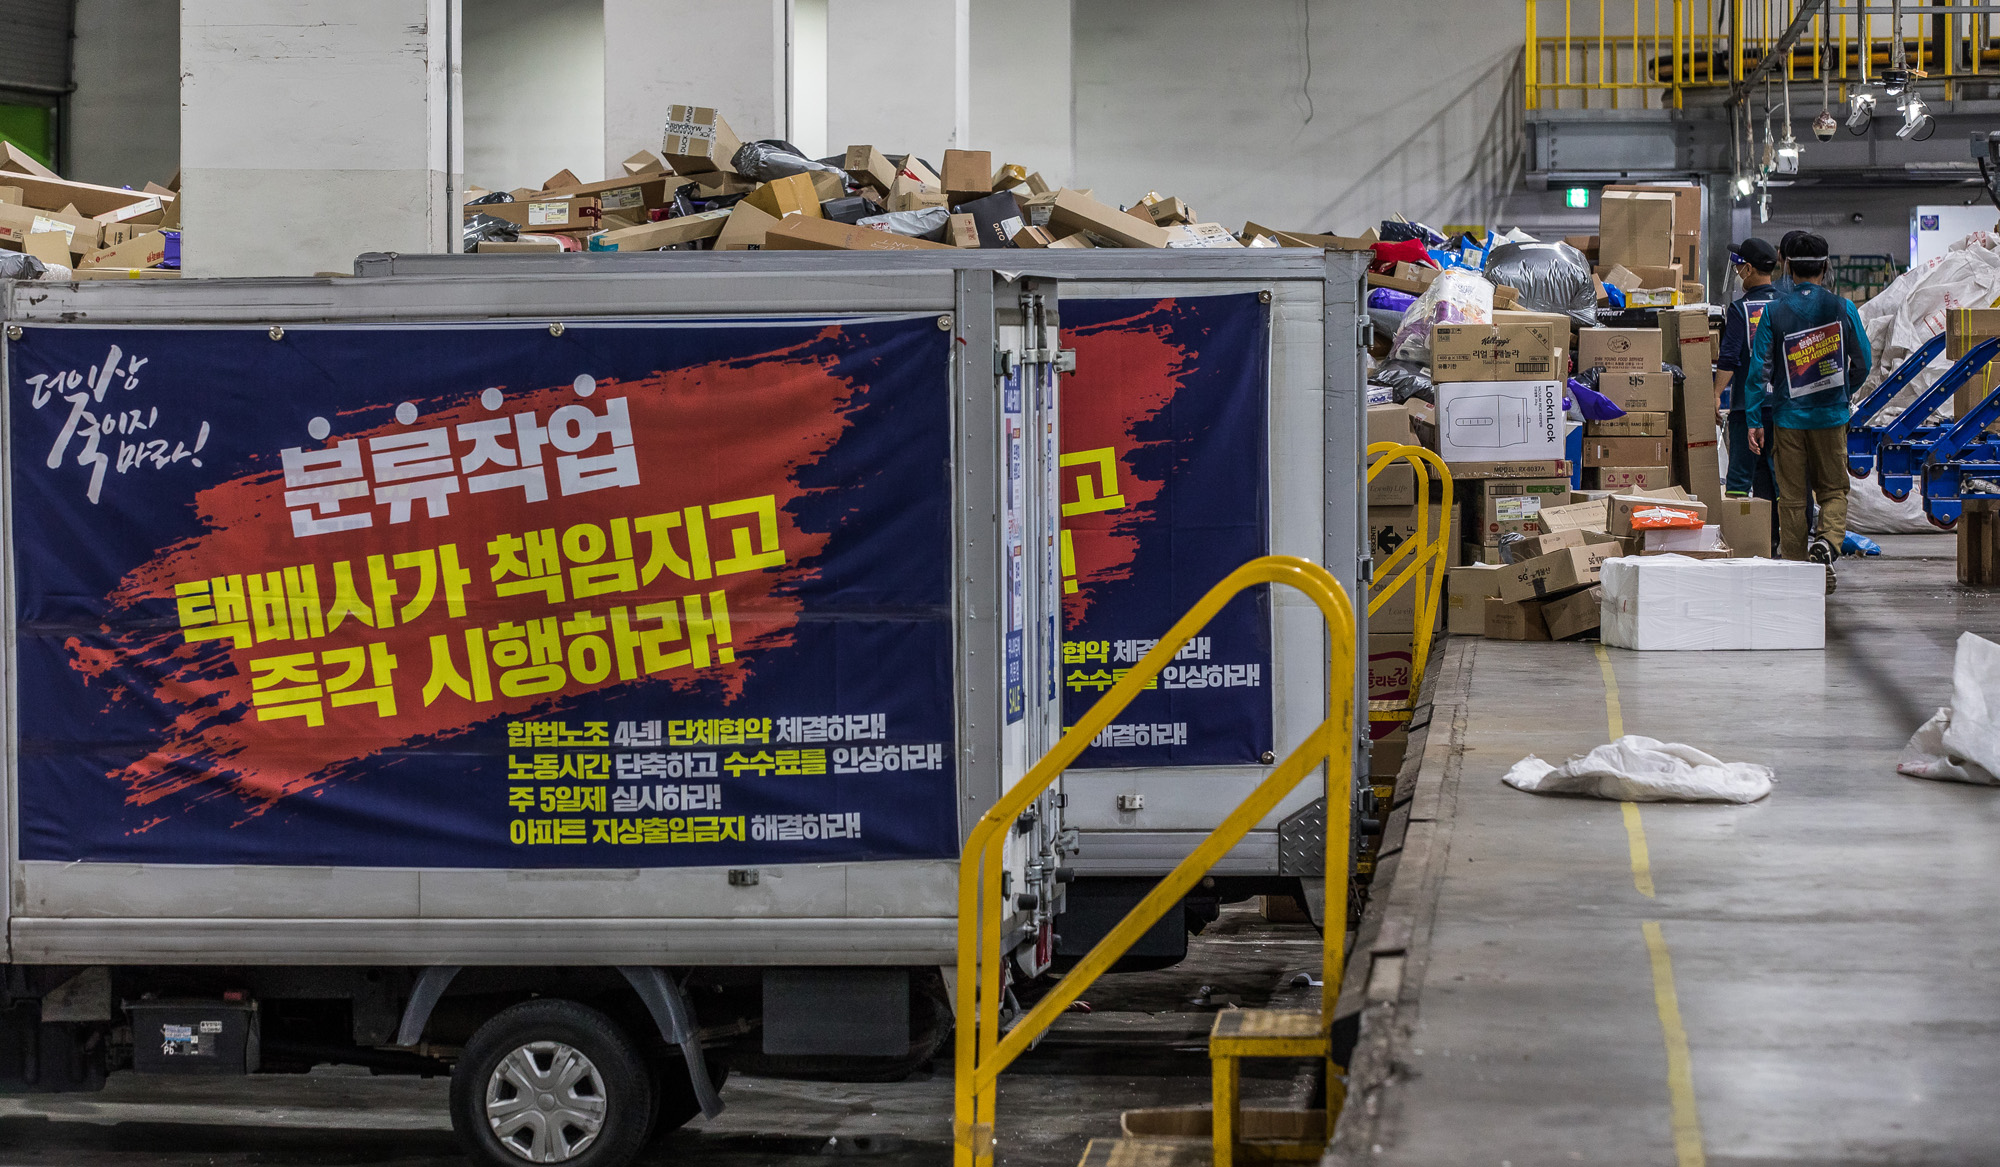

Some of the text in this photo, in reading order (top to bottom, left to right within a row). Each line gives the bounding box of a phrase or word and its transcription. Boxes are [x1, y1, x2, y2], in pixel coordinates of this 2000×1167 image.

[1545, 385, 1556, 443] LocknLock
[280, 374, 640, 538] 분류작업
[174, 494, 786, 649] 택배사가 책임지고
[1517, 573, 1529, 583] SG
[248, 589, 736, 728] 즉각 시행하라!
[1113, 636, 1211, 663] 체결라!
[1163, 664, 1261, 690] 인상하라!
[507, 721, 610, 748] 합법노조
[668, 717, 772, 746] 단체협약
[776, 713, 887, 743] 체결하라!
[508, 744, 943, 780] 노동시간 단축하고 수수료를 인상하라!
[508, 784, 722, 813] 주 5일제 실시하라!
[509, 812, 862, 845] 아파트 지상출입금지 해결하라!
